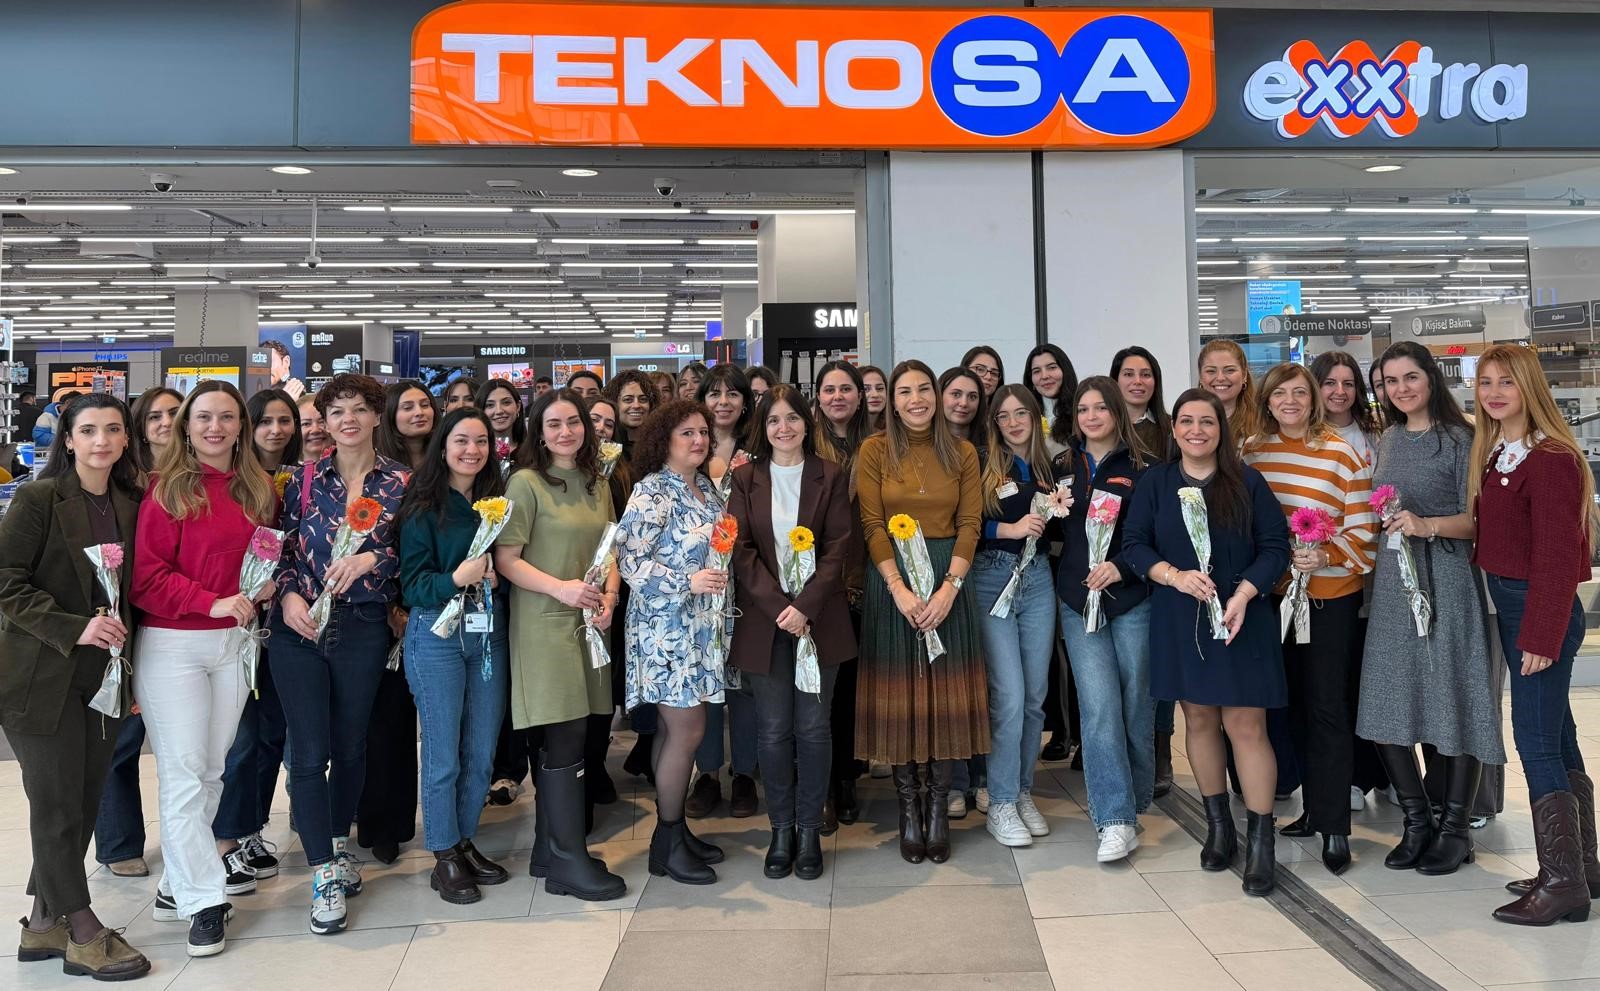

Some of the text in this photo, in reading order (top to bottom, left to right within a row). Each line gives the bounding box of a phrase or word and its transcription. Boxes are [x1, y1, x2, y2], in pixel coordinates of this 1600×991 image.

[441, 33, 1176, 109] TEKNOSA
[1243, 42, 1529, 132] exxtra
[1283, 317, 1371, 331] Ödeme Noktası
[1425, 318, 1471, 332] Kişisel Bakım
[311, 332, 334, 342] BRAUN
[480, 347, 526, 355] SAMSUNG
[677, 344, 690, 353] LG
[178, 351, 230, 363] realme
[637, 364, 658, 372] OLED
